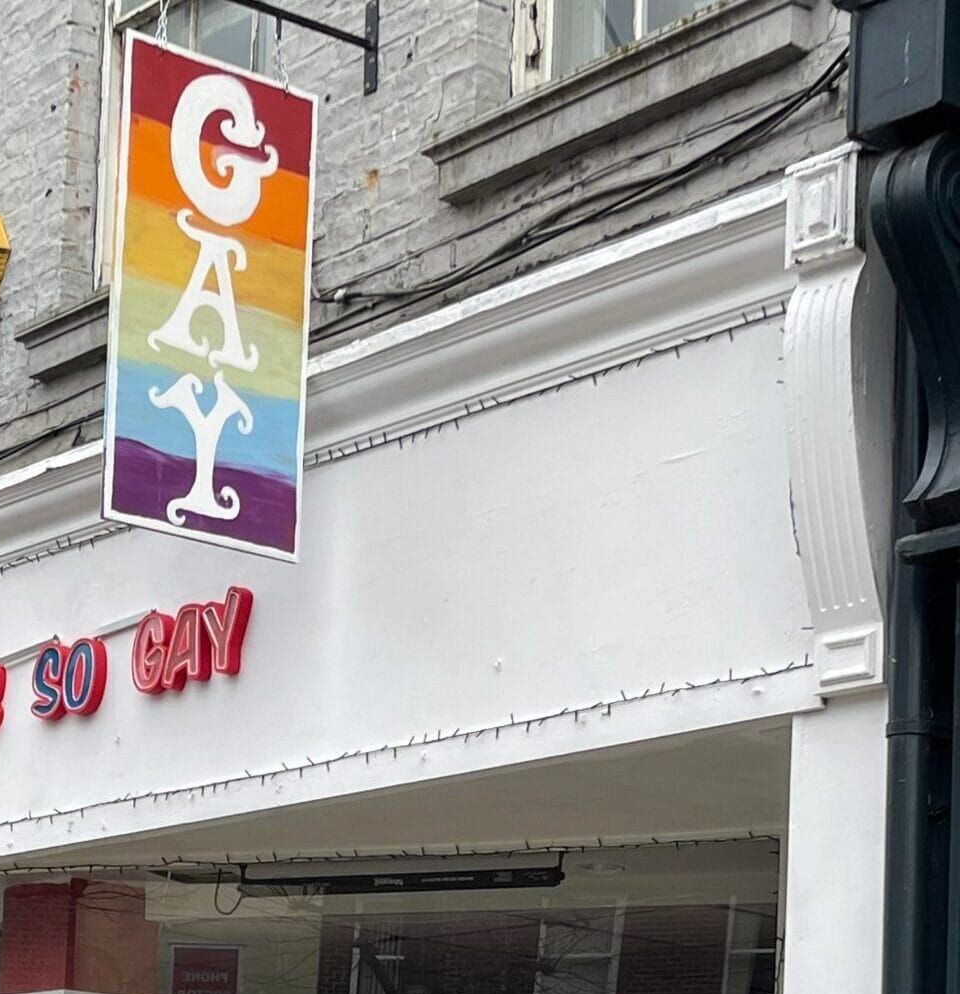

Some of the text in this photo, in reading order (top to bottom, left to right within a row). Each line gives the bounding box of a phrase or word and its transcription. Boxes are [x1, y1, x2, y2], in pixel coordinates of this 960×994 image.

[147, 74, 279, 526] GAY
[31, 637, 107, 721] SO
[131, 586, 254, 695] GAY
